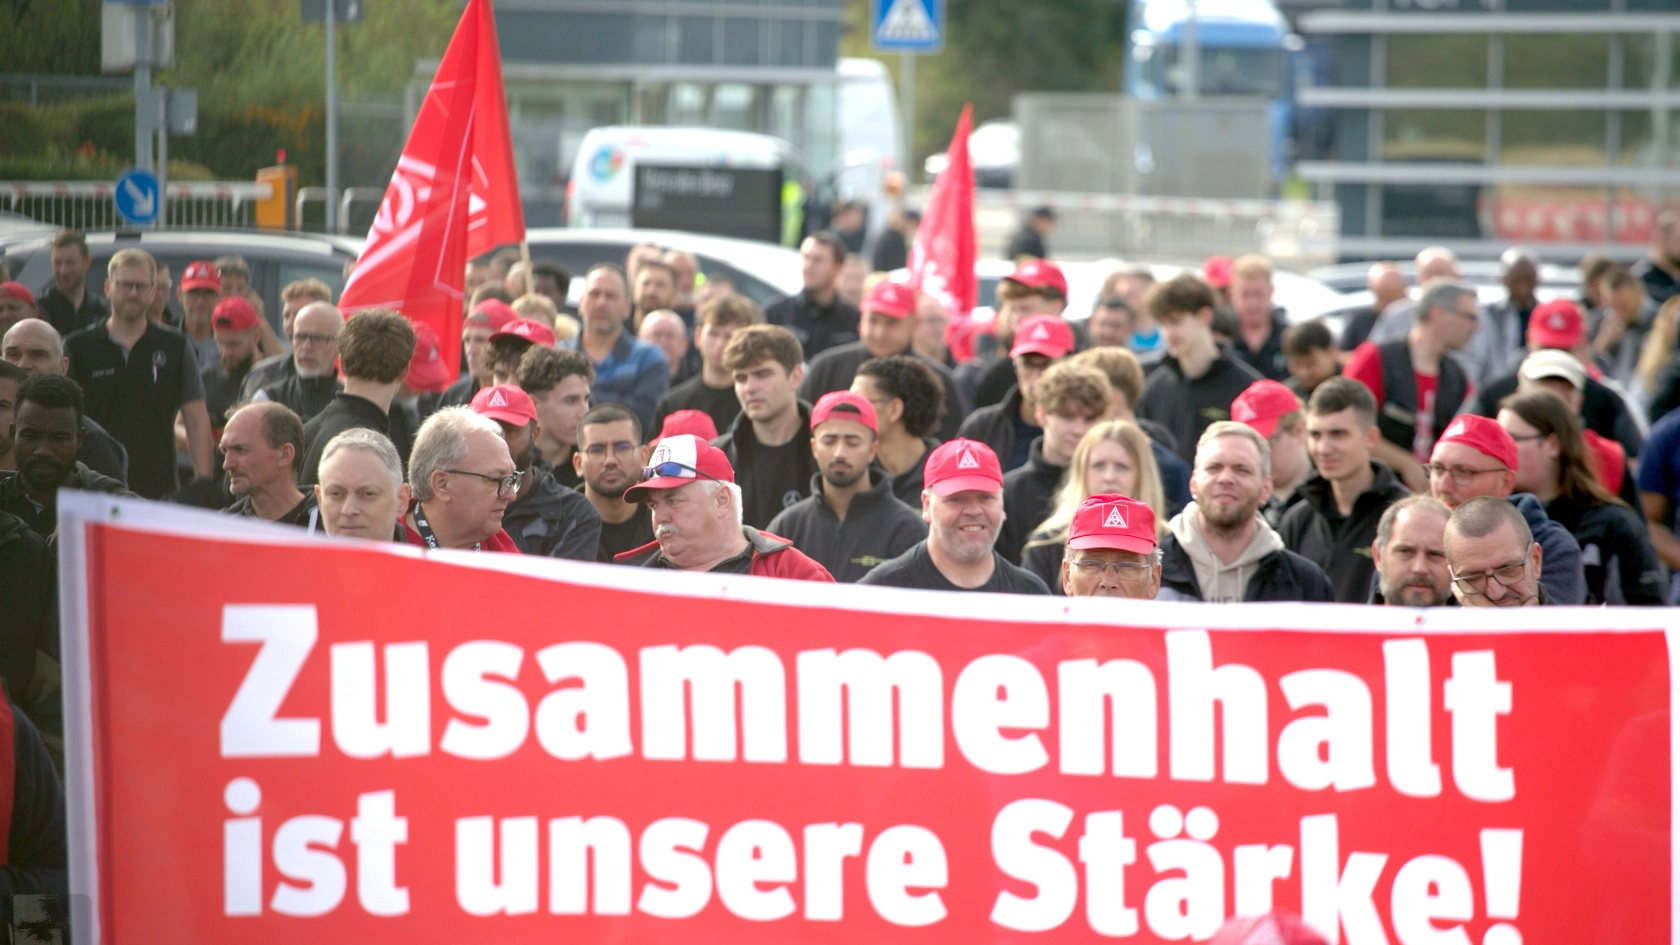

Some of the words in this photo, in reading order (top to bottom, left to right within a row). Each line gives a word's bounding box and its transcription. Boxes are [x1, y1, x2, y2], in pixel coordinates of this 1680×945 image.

[219, 603, 1516, 803] Zusammenhalt
[223, 777, 410, 917] ist
[455, 815, 949, 927] unsere
[989, 798, 1524, 945] Stärke!
